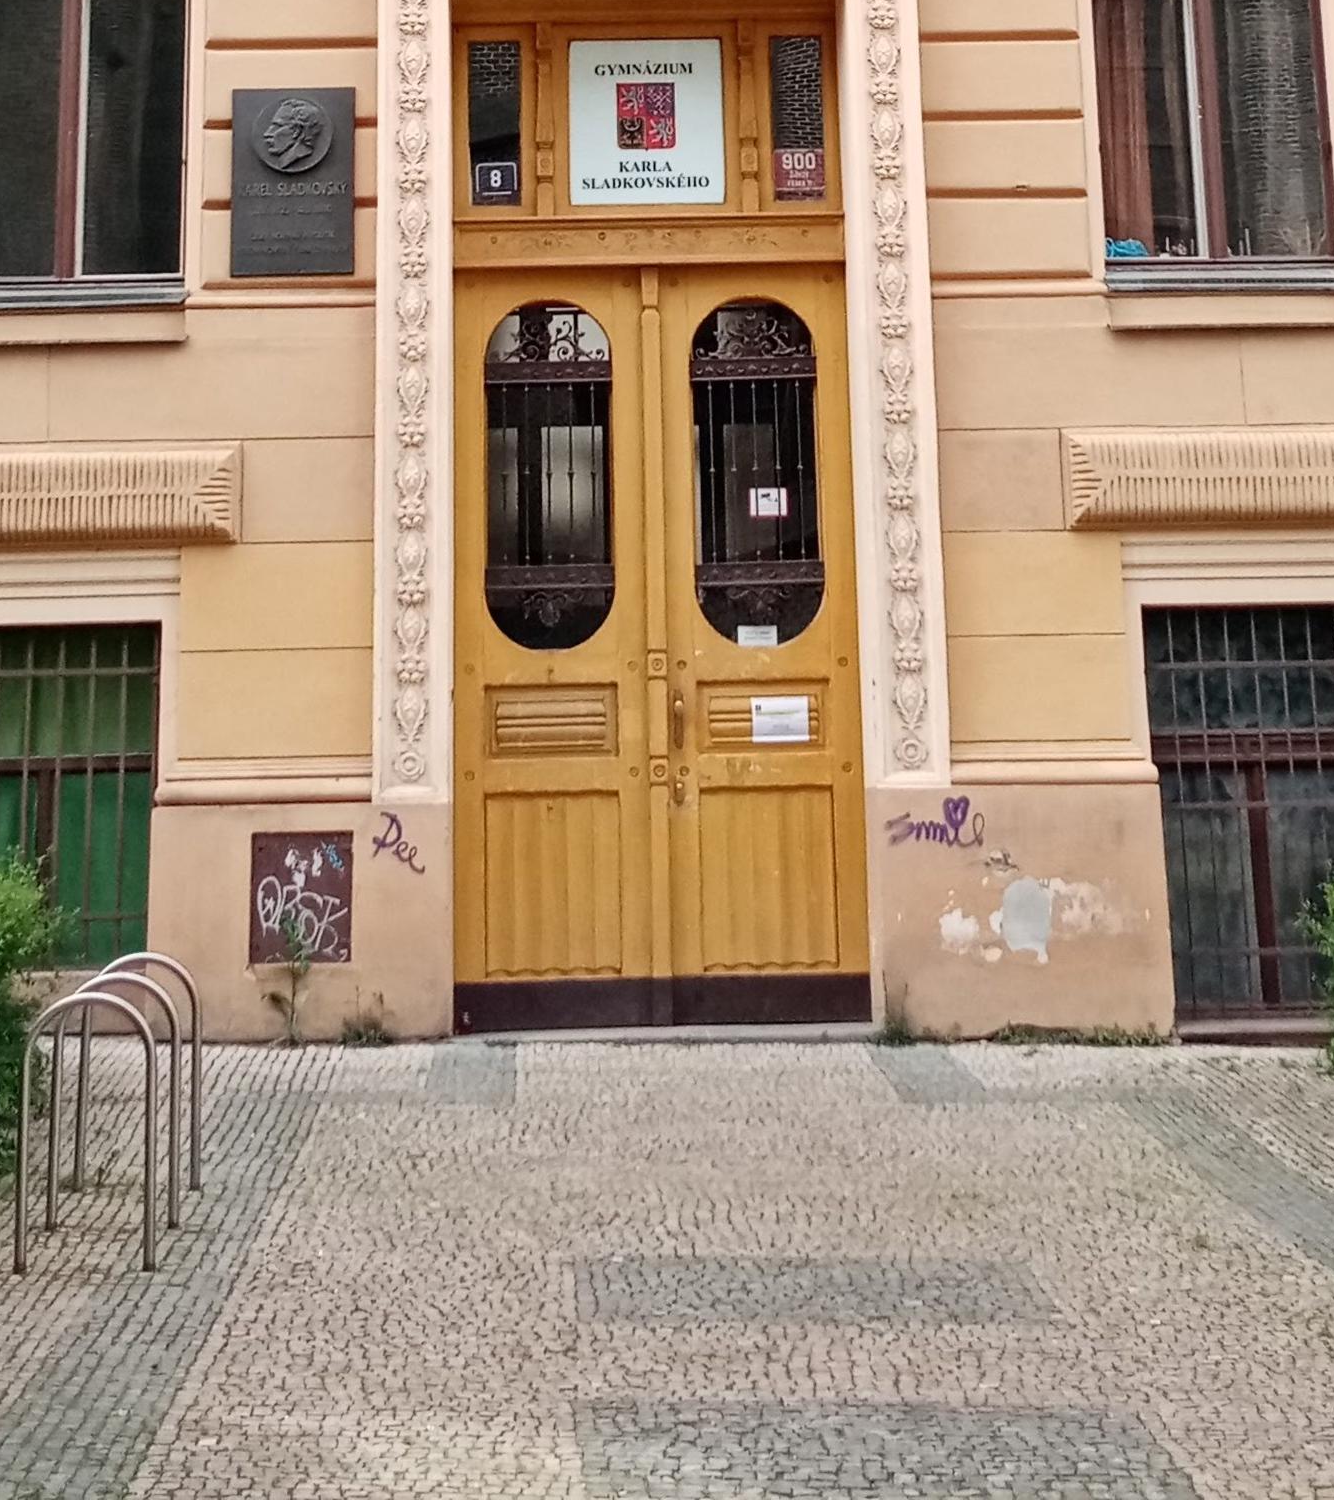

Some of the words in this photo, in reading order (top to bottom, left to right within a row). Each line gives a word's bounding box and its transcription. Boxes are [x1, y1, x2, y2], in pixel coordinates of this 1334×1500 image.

[593, 59, 693, 77] GYMNÁZIUM
[618, 160, 673, 173] KARLA
[781, 152, 816, 171] 900
[490, 169, 502, 188] 8
[581, 173, 711, 190] SLADKOVSKÉHO
